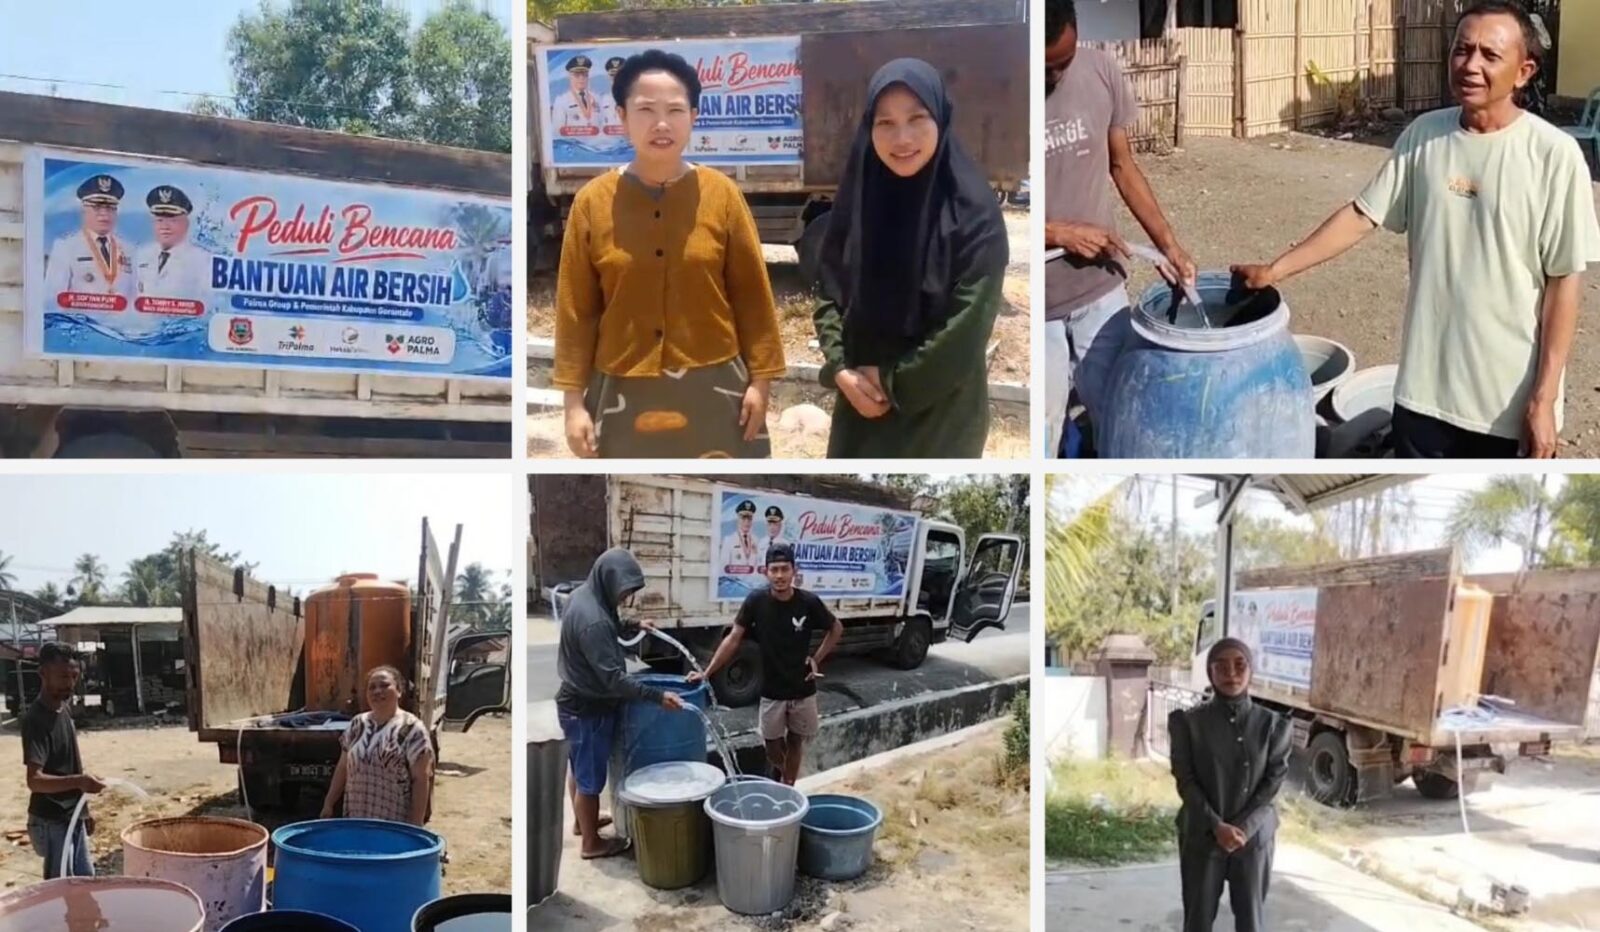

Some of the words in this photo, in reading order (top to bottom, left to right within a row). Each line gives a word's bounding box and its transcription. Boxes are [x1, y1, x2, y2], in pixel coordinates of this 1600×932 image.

[725, 95, 752, 116] AIR
[230, 195, 335, 253] Peduli
[338, 203, 458, 254] Bencana
[212, 256, 327, 297] BANTUAN
[330, 266, 369, 299] AIR
[373, 269, 453, 306] BERSIH
[243, 298, 267, 308] Palma
[268, 299, 292, 310] Group
[293, 301, 299, 309] &
[300, 301, 341, 312] Pemerintah
[342, 305, 377, 315] Kabupaten
[377, 307, 414, 317] Gorontalo
[278, 340, 315, 352] TriPalma
[408, 335, 436, 345] AGRO
[407, 345, 440, 355] PALMA
[798, 510, 837, 540] Peduli
[832, 545, 848, 561] AIR
[848, 546, 877, 562] BERSIH
